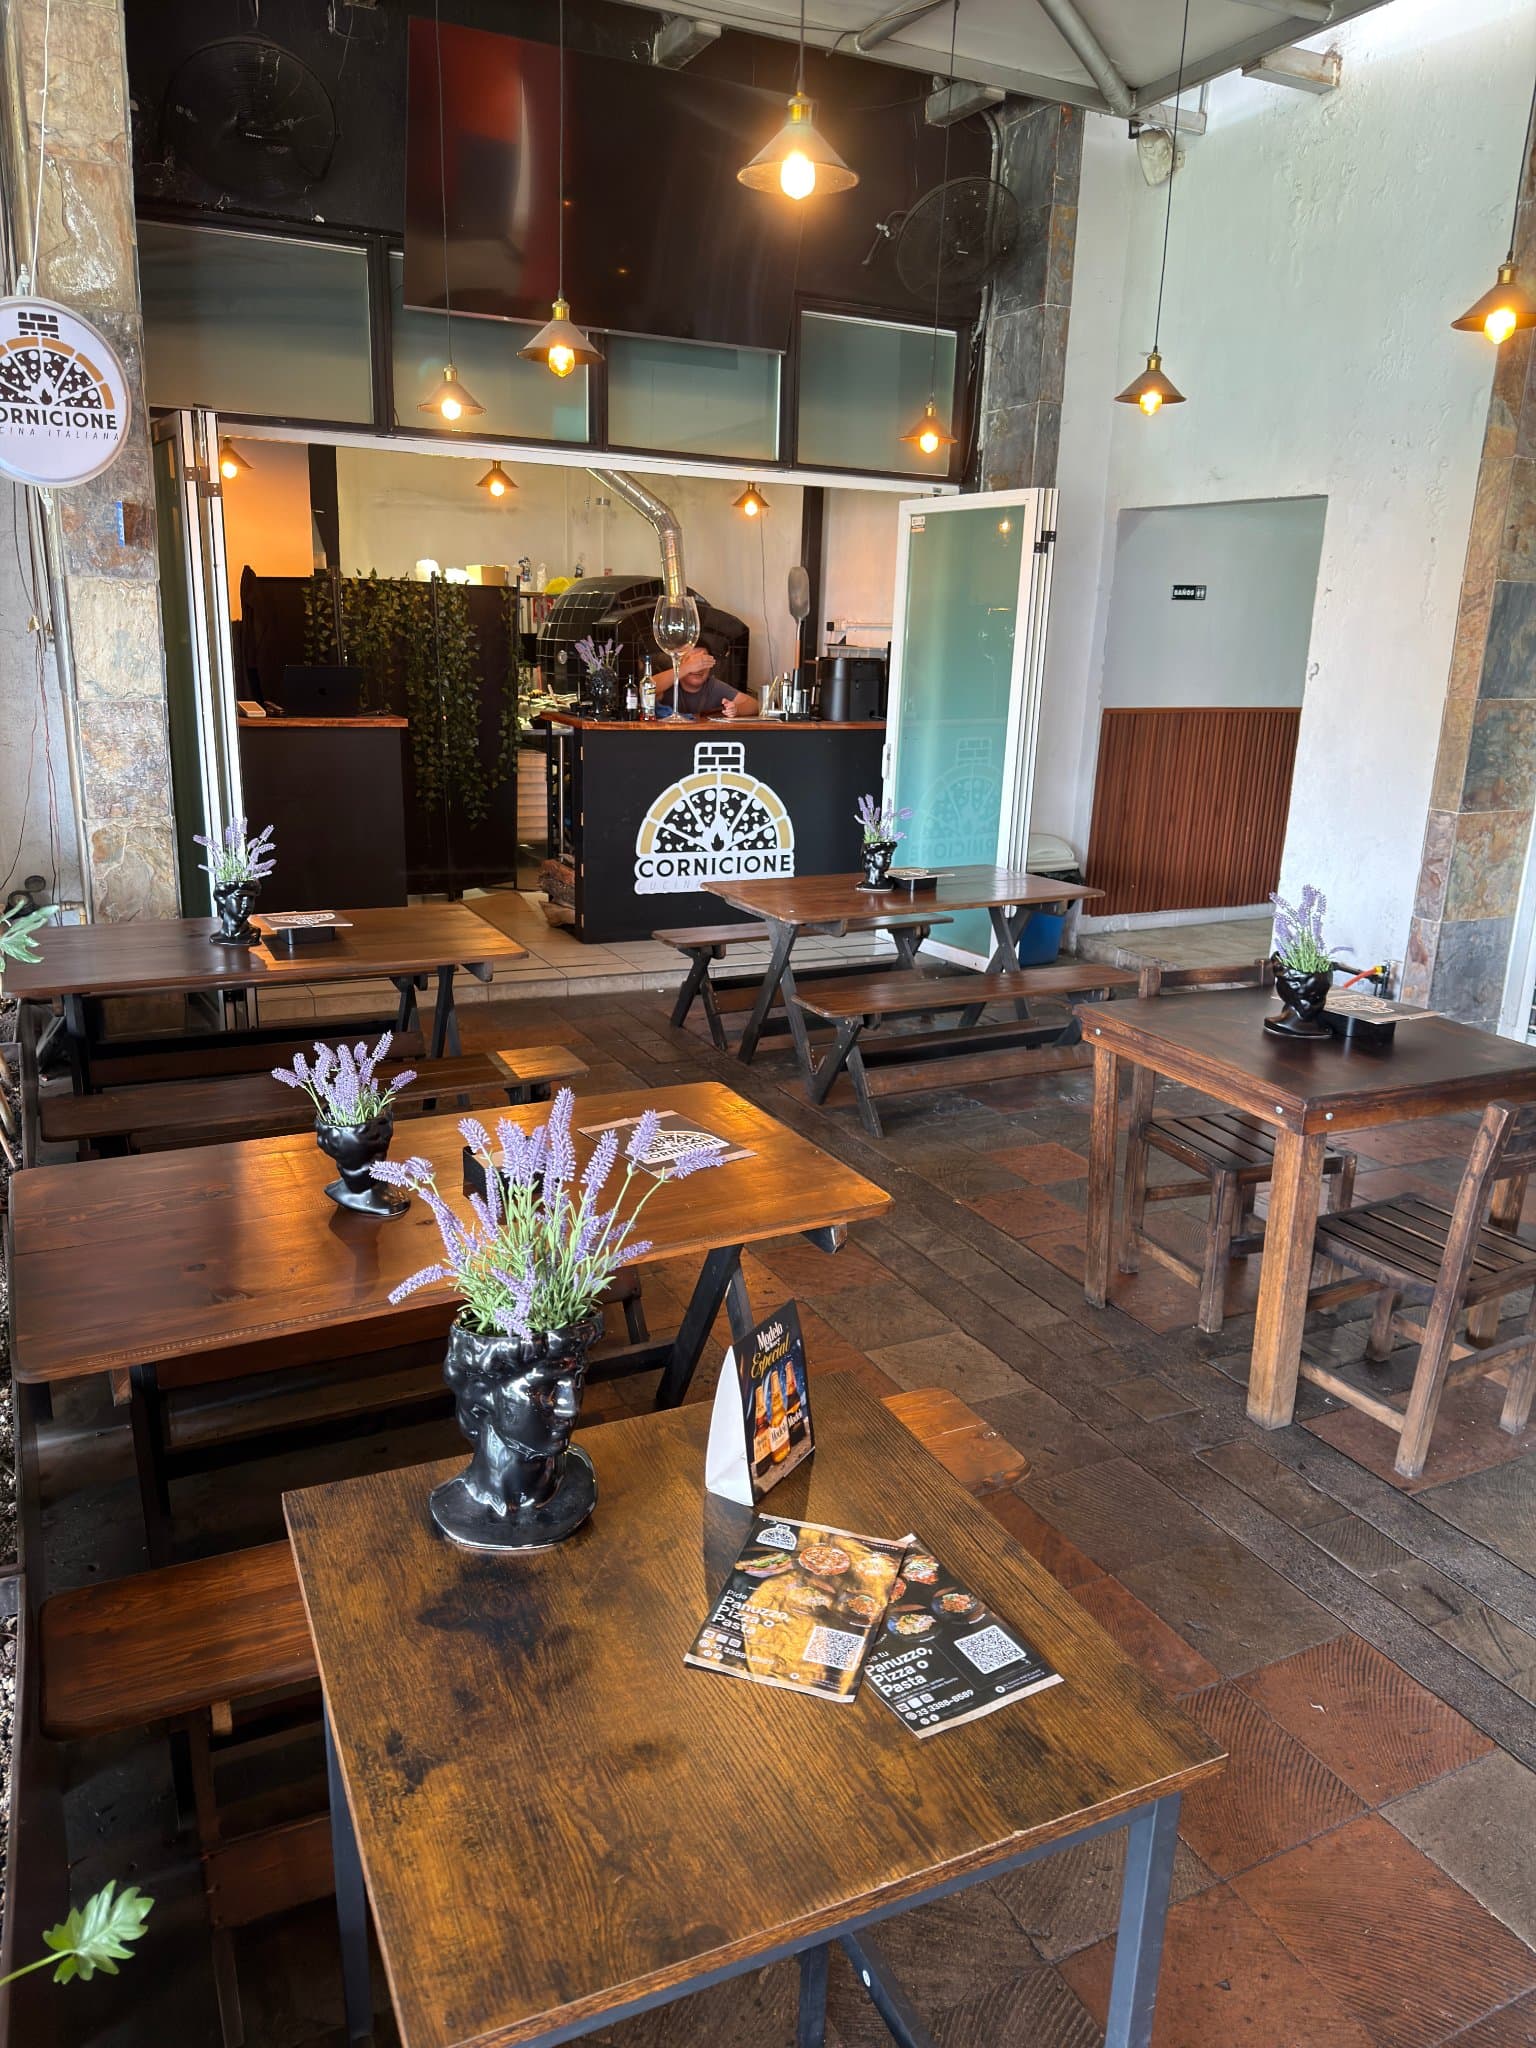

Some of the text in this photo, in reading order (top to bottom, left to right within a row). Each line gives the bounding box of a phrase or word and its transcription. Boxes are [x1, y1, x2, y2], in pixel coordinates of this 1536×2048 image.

[0, 407, 117, 430] ORNICIONE
[48, 429, 119, 441] ITALIANA
[638, 854, 791, 878] CORNICIONE
[638, 878, 702, 891] CUCIN
[649, 1139, 723, 1159] ORNICIONE
[756, 1321, 784, 1350] Modelo
[751, 1331, 791, 1379] Especial
[726, 1589, 748, 1599] Pide
[717, 1604, 775, 1628] Pizza o
[721, 1596, 790, 1623] Panuzzo,
[711, 1613, 756, 1635] Pasta
[864, 1647, 933, 1676] Panuzzo,
[871, 1660, 929, 1687] Pizza o
[879, 1674, 927, 1698] Pasta
[915, 1707, 929, 1717] 33
